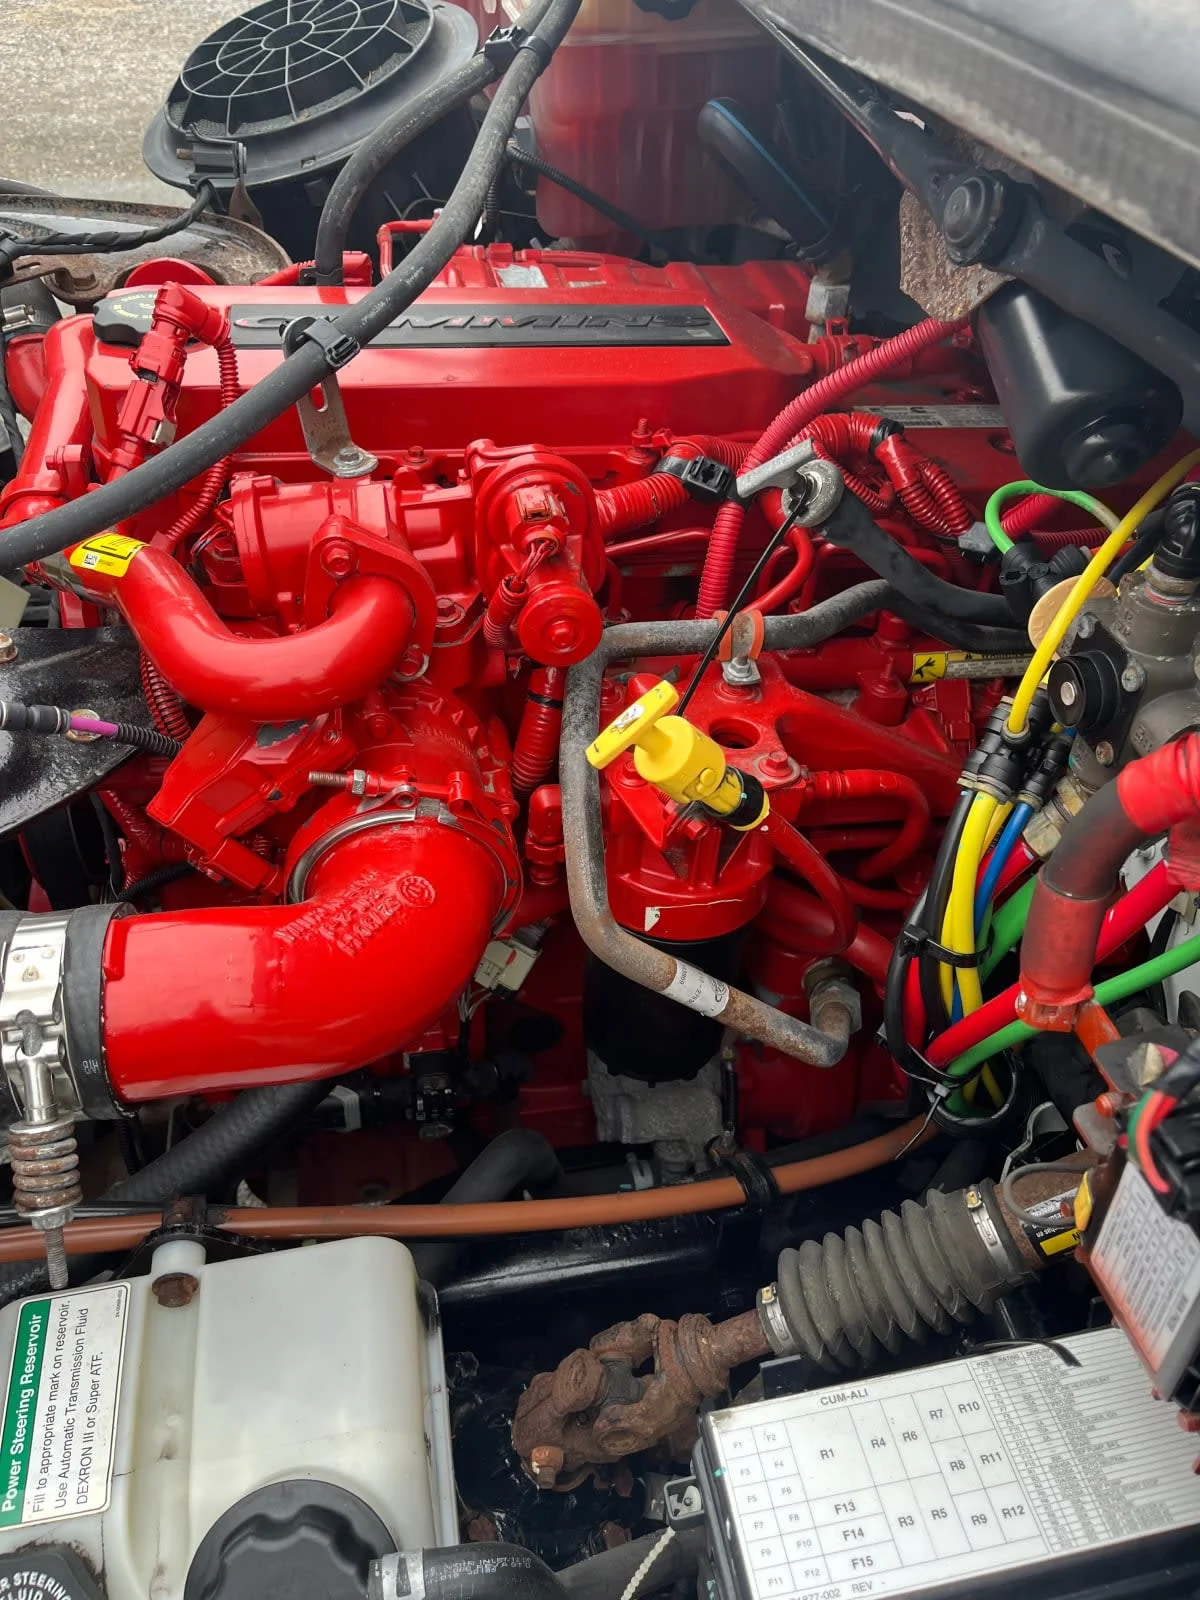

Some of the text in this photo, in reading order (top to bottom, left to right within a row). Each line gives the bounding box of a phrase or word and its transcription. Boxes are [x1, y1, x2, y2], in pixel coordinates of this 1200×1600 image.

[20, 1314, 42, 1385] Reservoir
[820, 1388, 868, 1406] CUM-ALI
[32, 1300, 70, 1512] Fill to appropriate mark on reservoir.
[55, 1308, 88, 1509] Use Automatic Transmission Fluid
[958, 1401, 980, 1414] R10
[929, 1409, 944, 1420] R7
[10, 1389, 34, 1455] Steering
[76, 1352, 104, 1504] DEXRON III or Super ATF.
[766, 1434, 776, 1442] F2
[902, 1430, 918, 1442] R6
[870, 1437, 887, 1449] R4
[820, 1448, 835, 1460] R1
[980, 1452, 1002, 1466] R11
[950, 1460, 966, 1472] R8
[1, 1459, 21, 1512] Power
[834, 1502, 856, 1514] F13
[931, 1508, 948, 1520] R5
[1002, 1505, 1026, 1520] R12
[754, 1522, 764, 1530] F7
[898, 1515, 914, 1528] R3
[971, 1514, 988, 1526] R9
[842, 1528, 865, 1541] F14
[796, 1539, 812, 1549] F10
[852, 1556, 874, 1570] F15
[804, 1569, 821, 1579] F12
[852, 1580, 873, 1592] REV
